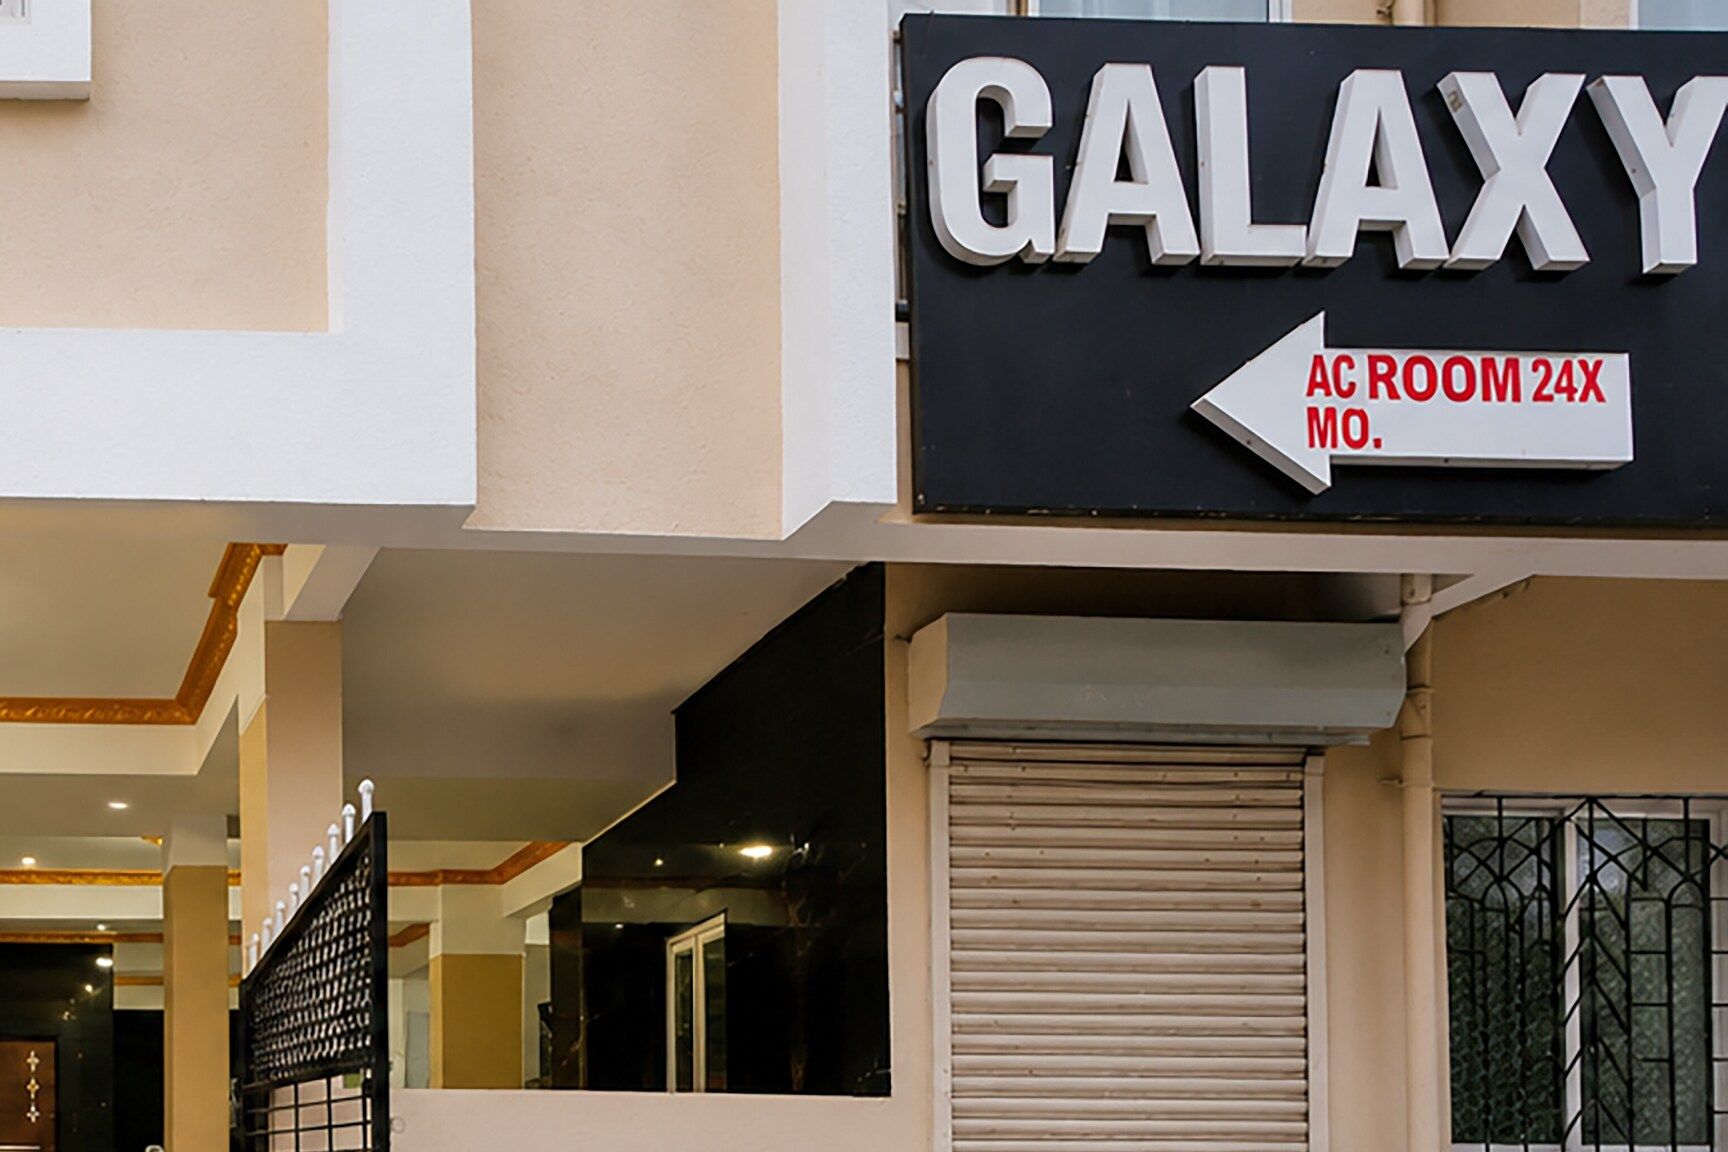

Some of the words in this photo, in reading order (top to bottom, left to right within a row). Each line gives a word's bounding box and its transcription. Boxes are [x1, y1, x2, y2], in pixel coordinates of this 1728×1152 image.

[925, 55, 1728, 275] GALAXY
[1306, 354, 1357, 399] AC
[1367, 354, 1522, 403] ROOM
[1530, 358, 1607, 404] 24X
[1306, 406, 1383, 450] MO.
